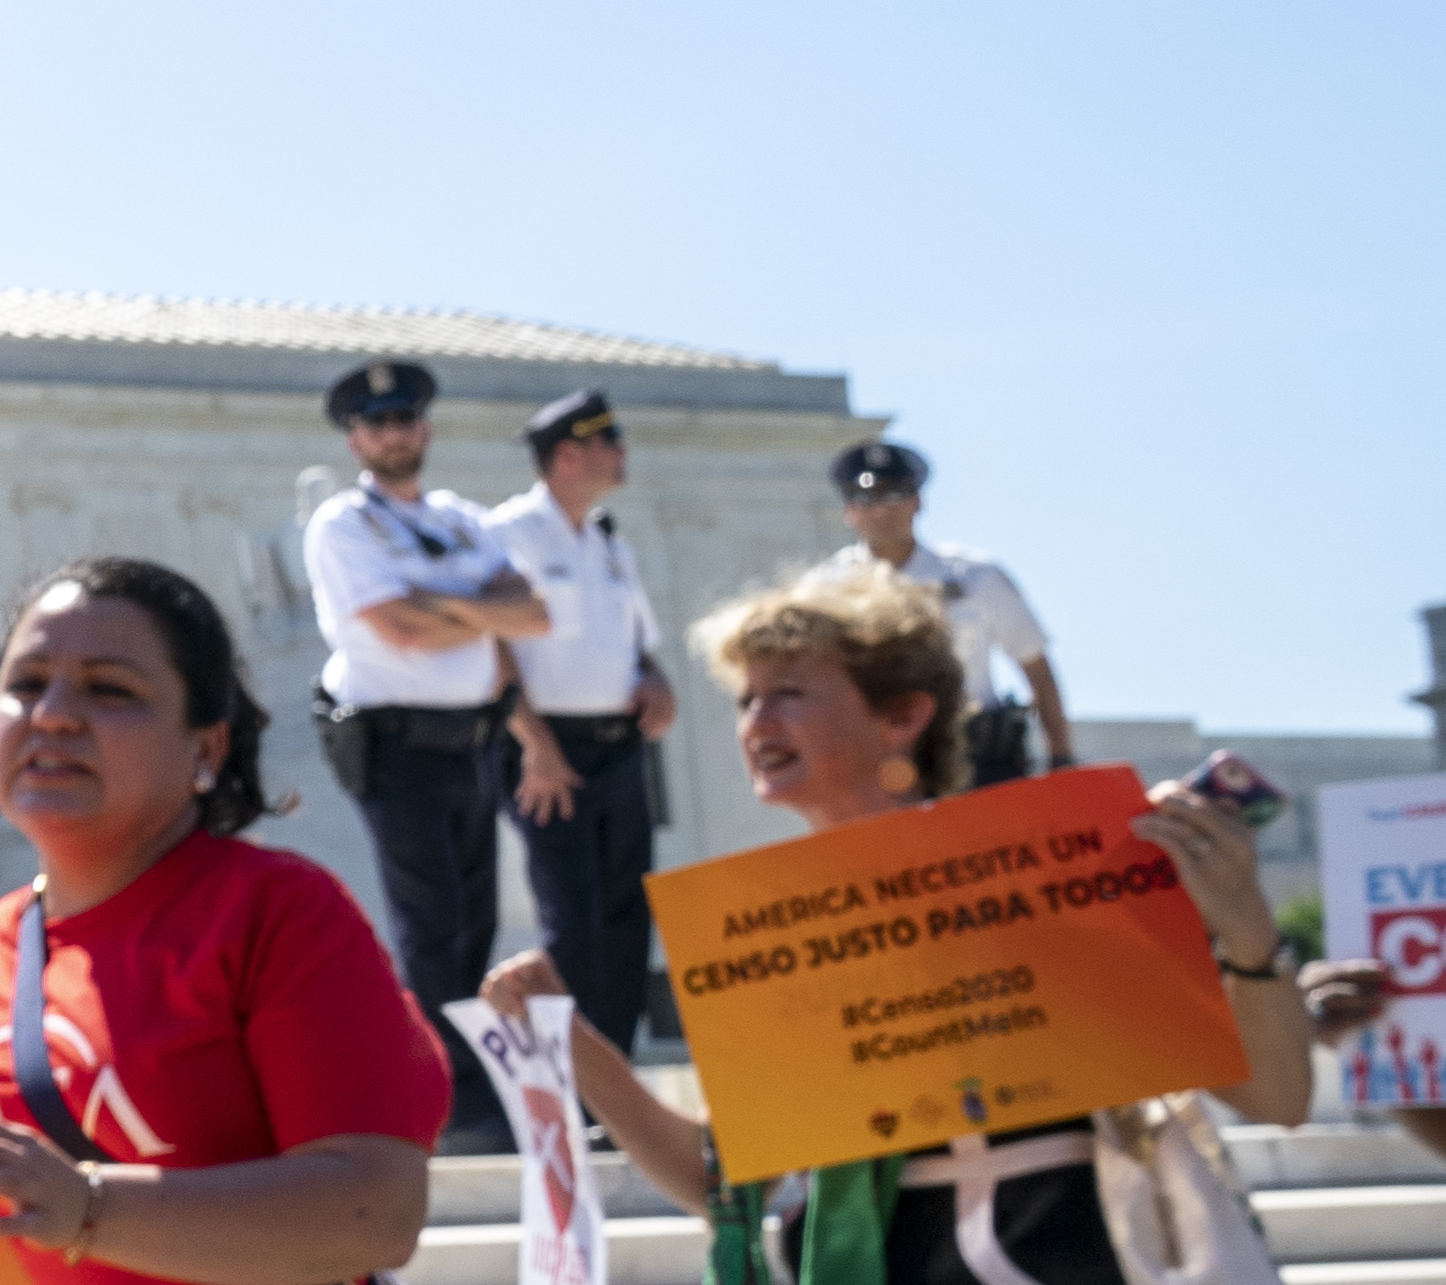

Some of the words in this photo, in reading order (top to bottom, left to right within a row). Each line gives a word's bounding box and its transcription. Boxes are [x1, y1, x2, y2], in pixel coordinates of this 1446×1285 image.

[683, 945, 797, 997] CENSO
[802, 916, 920, 969] JUSTO
[925, 889, 1035, 940] PARA
[1037, 857, 1180, 914] TODOS
[723, 883, 866, 940] AMERICA
[872, 843, 1043, 904] NECESITA
[1047, 826, 1103, 864] UN
[1382, 917, 1446, 986] C
